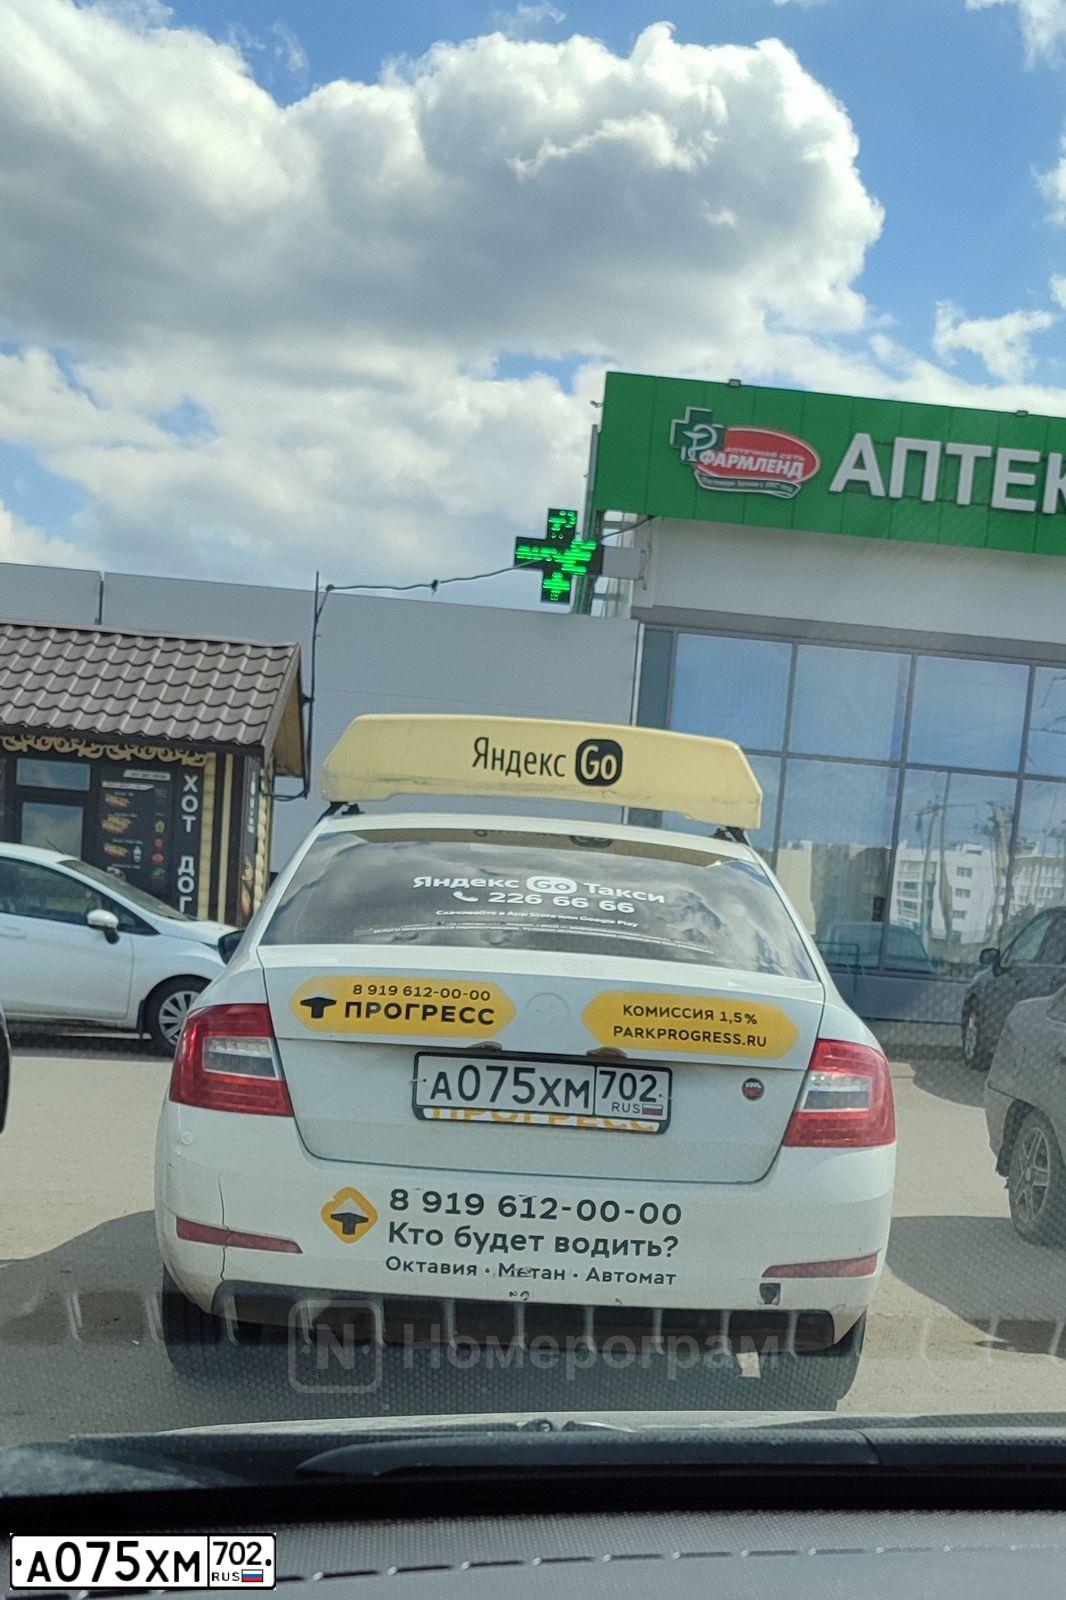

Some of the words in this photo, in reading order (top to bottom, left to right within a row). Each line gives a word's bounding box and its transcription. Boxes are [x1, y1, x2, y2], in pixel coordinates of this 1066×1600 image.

[699, 450, 806, 479] ФАРМЛЕНД
[471, 736, 567, 778] Яндекс
[580, 745, 618, 780] Go
[180, 774, 199, 833] ХОТ
[176, 855, 196, 914] ДОГ
[413, 876, 520, 890] Яндекс
[583, 882, 666, 904] Такси
[488, 891, 543, 905] 226
[552, 896, 590, 909] 66
[599, 900, 635, 914] 66
[352, 984, 363, 995] 8
[367, 984, 398, 997] 919
[402, 986, 491, 1001] 612-00-00
[344, 1001, 496, 1026] ПРОГРЕСС
[622, 1004, 714, 1021] КОМИССИЯ
[719, 1011, 758, 1025] 1,5%
[613, 1025, 767, 1048] PARKPROGRESS.RU
[598, 1070, 658, 1104] 702
[611, 1102, 641, 1114] RUS
[389, 1188, 409, 1211] 8
[422, 1190, 485, 1216] 919
[498, 1195, 682, 1226] 612-00-00
[388, 1221, 444, 1246] Кто
[454, 1225, 545, 1255] будет
[554, 1236, 679, 1259] водить?
[385, 1255, 478, 1277] Октавия
[498, 1262, 566, 1281] Метан
[585, 1266, 677, 1286] Автомат
